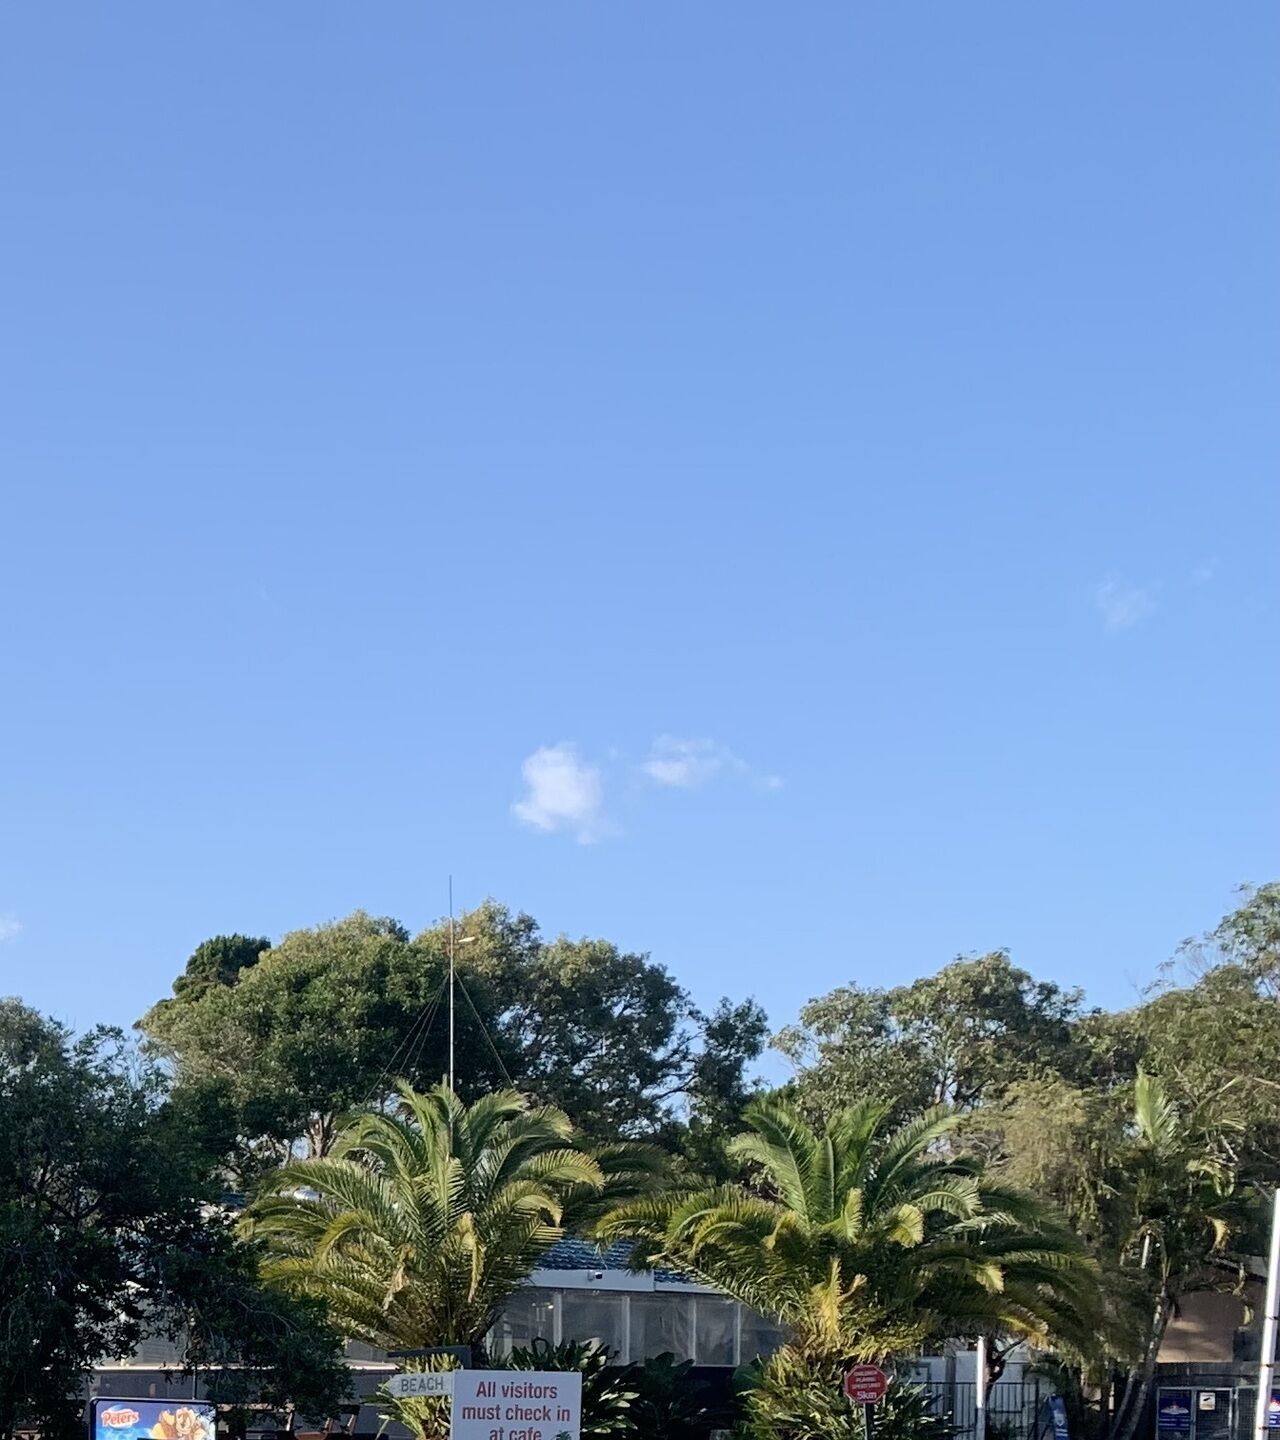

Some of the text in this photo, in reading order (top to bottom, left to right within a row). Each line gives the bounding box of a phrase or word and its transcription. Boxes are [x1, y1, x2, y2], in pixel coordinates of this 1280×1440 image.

[401, 1375, 444, 1393] BEACH
[476, 1381, 558, 1399] All visitors
[103, 1410, 139, 1426] Peters
[462, 1404, 571, 1422] must check in
